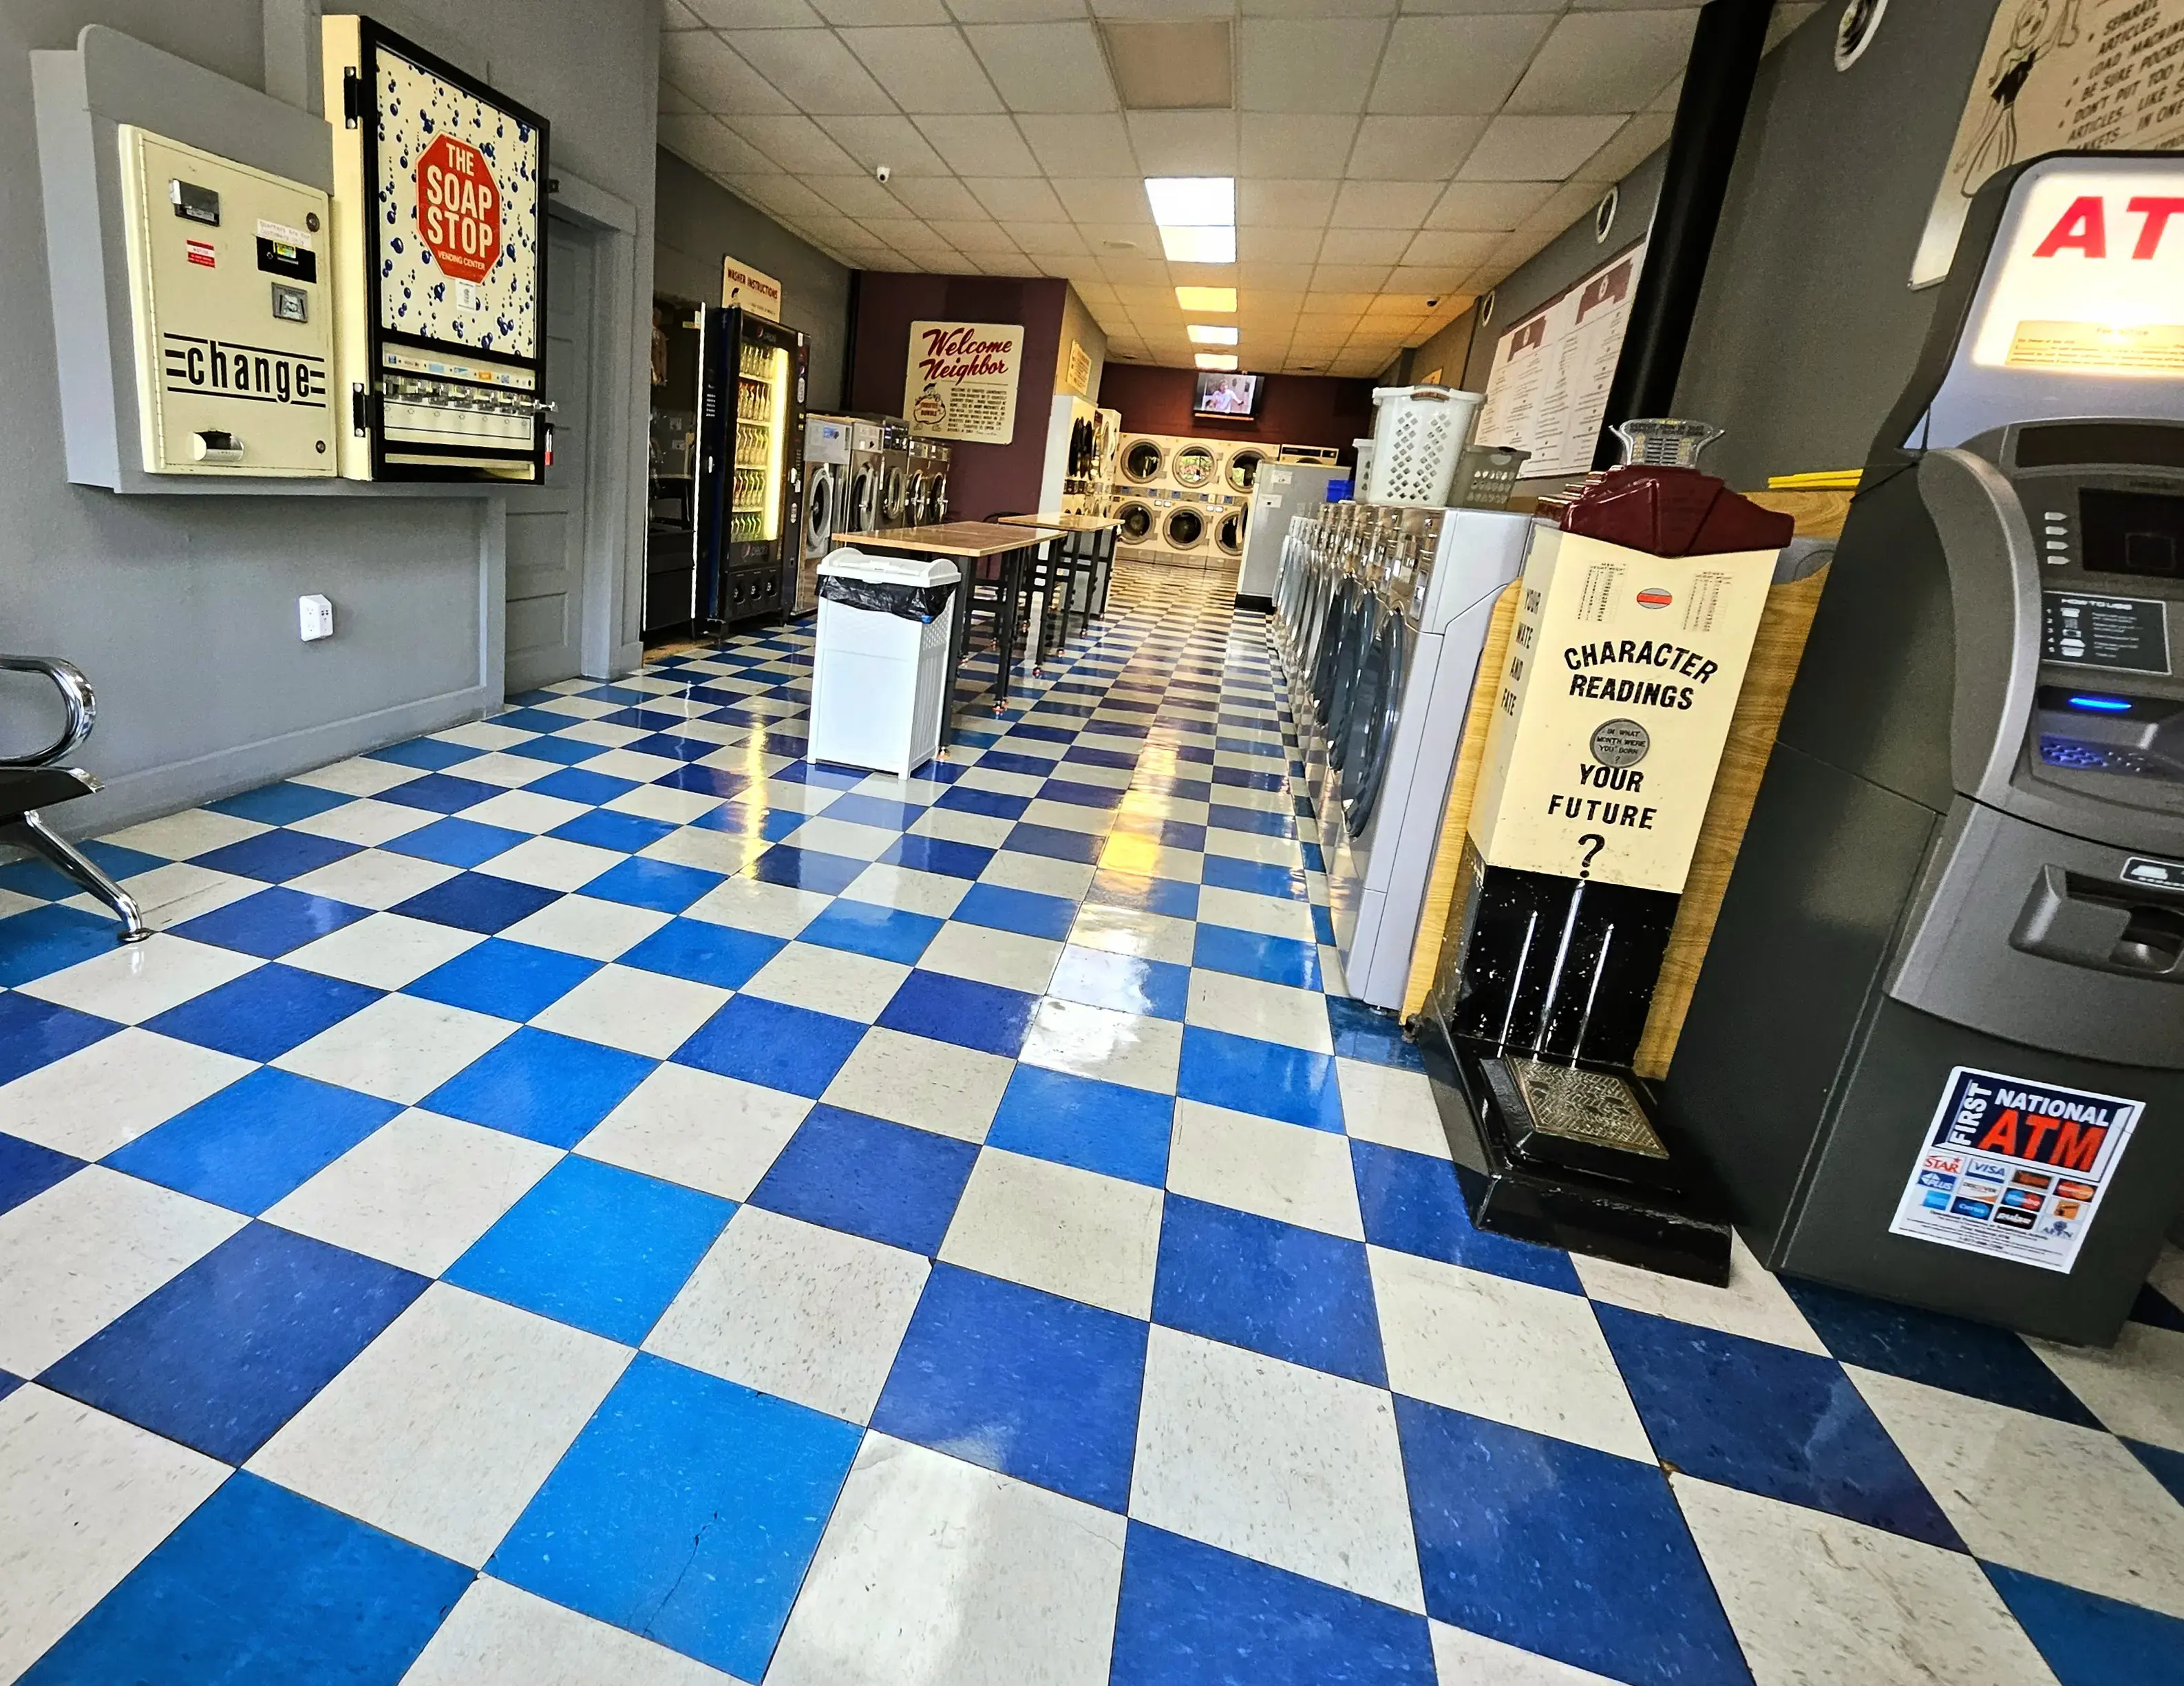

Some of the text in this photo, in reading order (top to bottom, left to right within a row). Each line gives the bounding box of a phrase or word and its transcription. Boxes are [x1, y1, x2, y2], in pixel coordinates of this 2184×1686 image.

[447, 143, 474, 177] THE
[427, 165, 492, 221] SOAP
[427, 206, 493, 258] STOP
[438, 250, 485, 271] VENDING CENTER
[728, 268, 778, 299] WASHER INSTRUCTIONS
[922, 327, 1013, 357] Welcome
[188, 339, 310, 403] change
[919, 354, 1008, 386] Neighbor
[1524, 587, 1542, 615] YOUR
[1509, 656, 1523, 682] AND
[1564, 640, 1719, 684] CHARACTER
[1501, 687, 1517, 717] FATE
[1569, 673, 1694, 710] READINGS
[1597, 736, 1646, 748] MONTH WERE
[1619, 729, 1640, 737] WHAT
[1619, 747, 1638, 755] BORN
[1580, 763, 1644, 793] YOUR
[1548, 794, 1657, 830] FUTURE
[1578, 833, 1605, 878] ?
[1950, 1083, 1992, 1146] FIRST
[1995, 1088, 2109, 1127] NATIONAL
[1976, 1108, 2107, 1173] ATM
[1924, 1157, 1960, 1173] STAR
[1975, 1162, 2005, 1176] VISA
